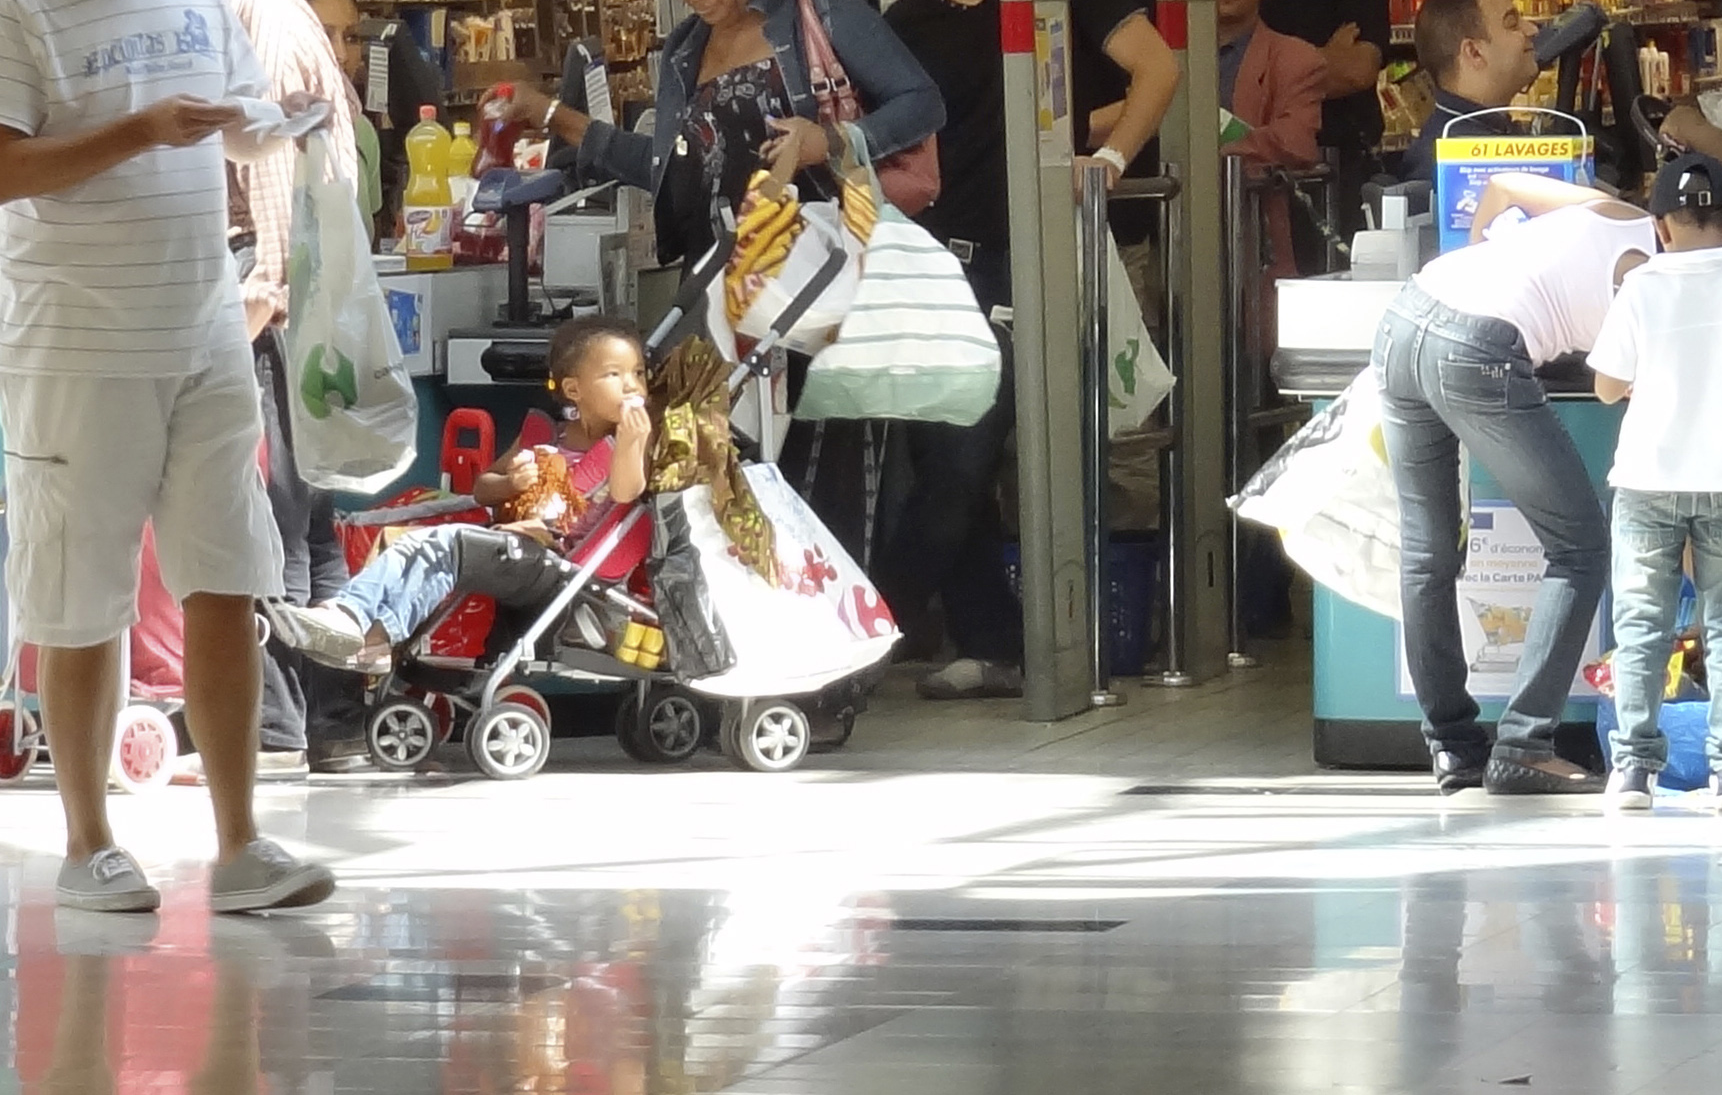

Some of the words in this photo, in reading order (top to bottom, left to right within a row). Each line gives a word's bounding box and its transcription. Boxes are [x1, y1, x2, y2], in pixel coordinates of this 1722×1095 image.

[1471, 143, 1488, 157] 61
[1495, 142, 1569, 156] LAVAGES
[1486, 560, 1539, 570] moyenne
[1480, 572, 1490, 582] la
[1492, 573, 1524, 582] Carte
[1526, 573, 1543, 582] PA
